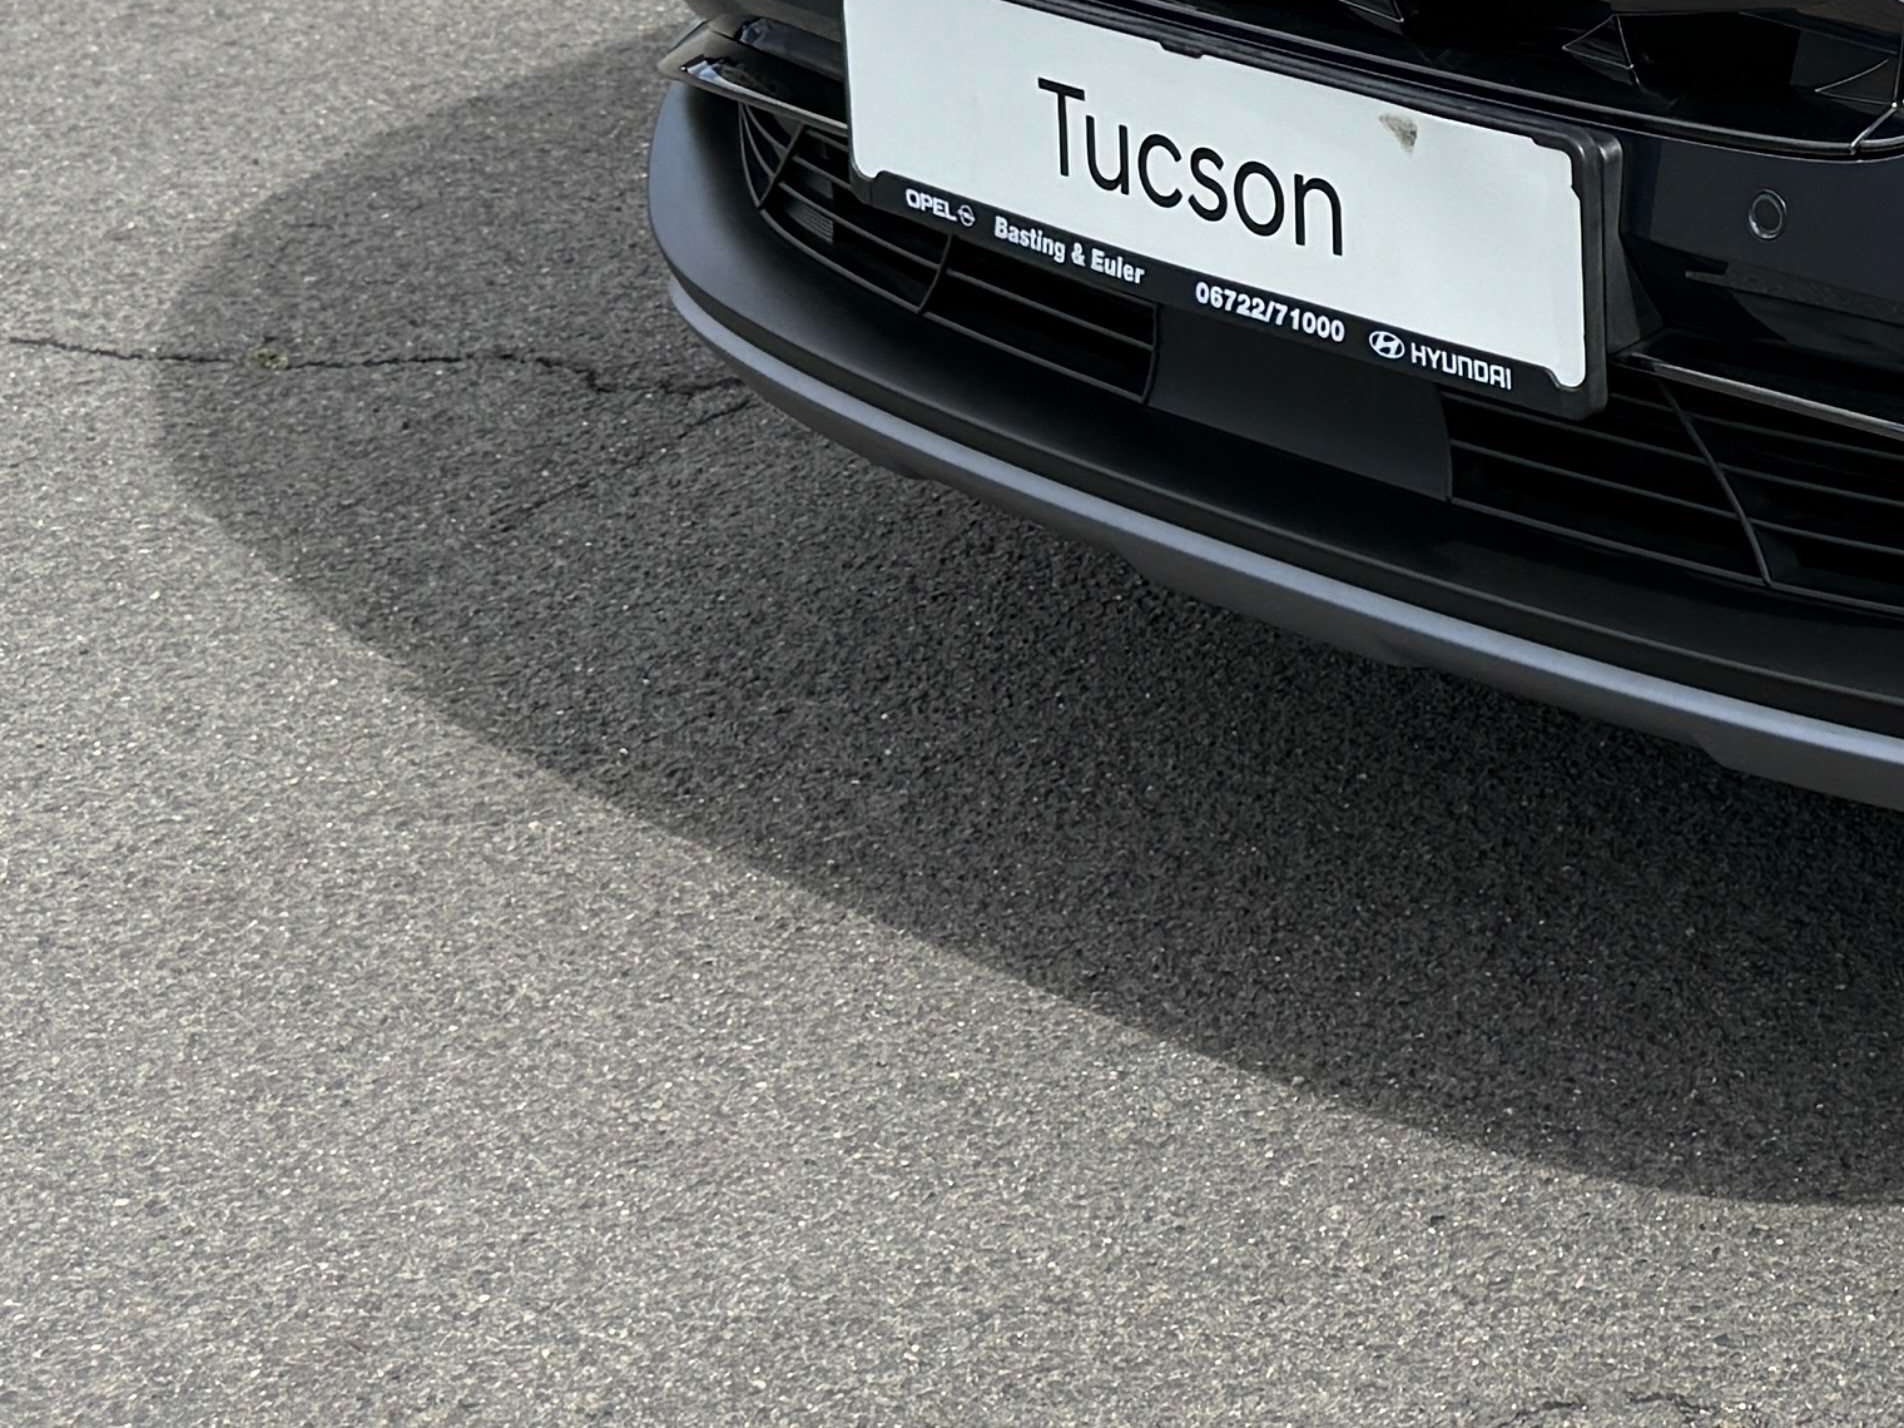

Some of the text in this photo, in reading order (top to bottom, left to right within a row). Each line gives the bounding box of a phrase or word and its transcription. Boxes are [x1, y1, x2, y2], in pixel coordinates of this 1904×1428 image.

[1036, 76, 1344, 258] Tucson
[904, 188, 1513, 391] OPEL Basting & Euler 06722/71000 HYUNDAI
